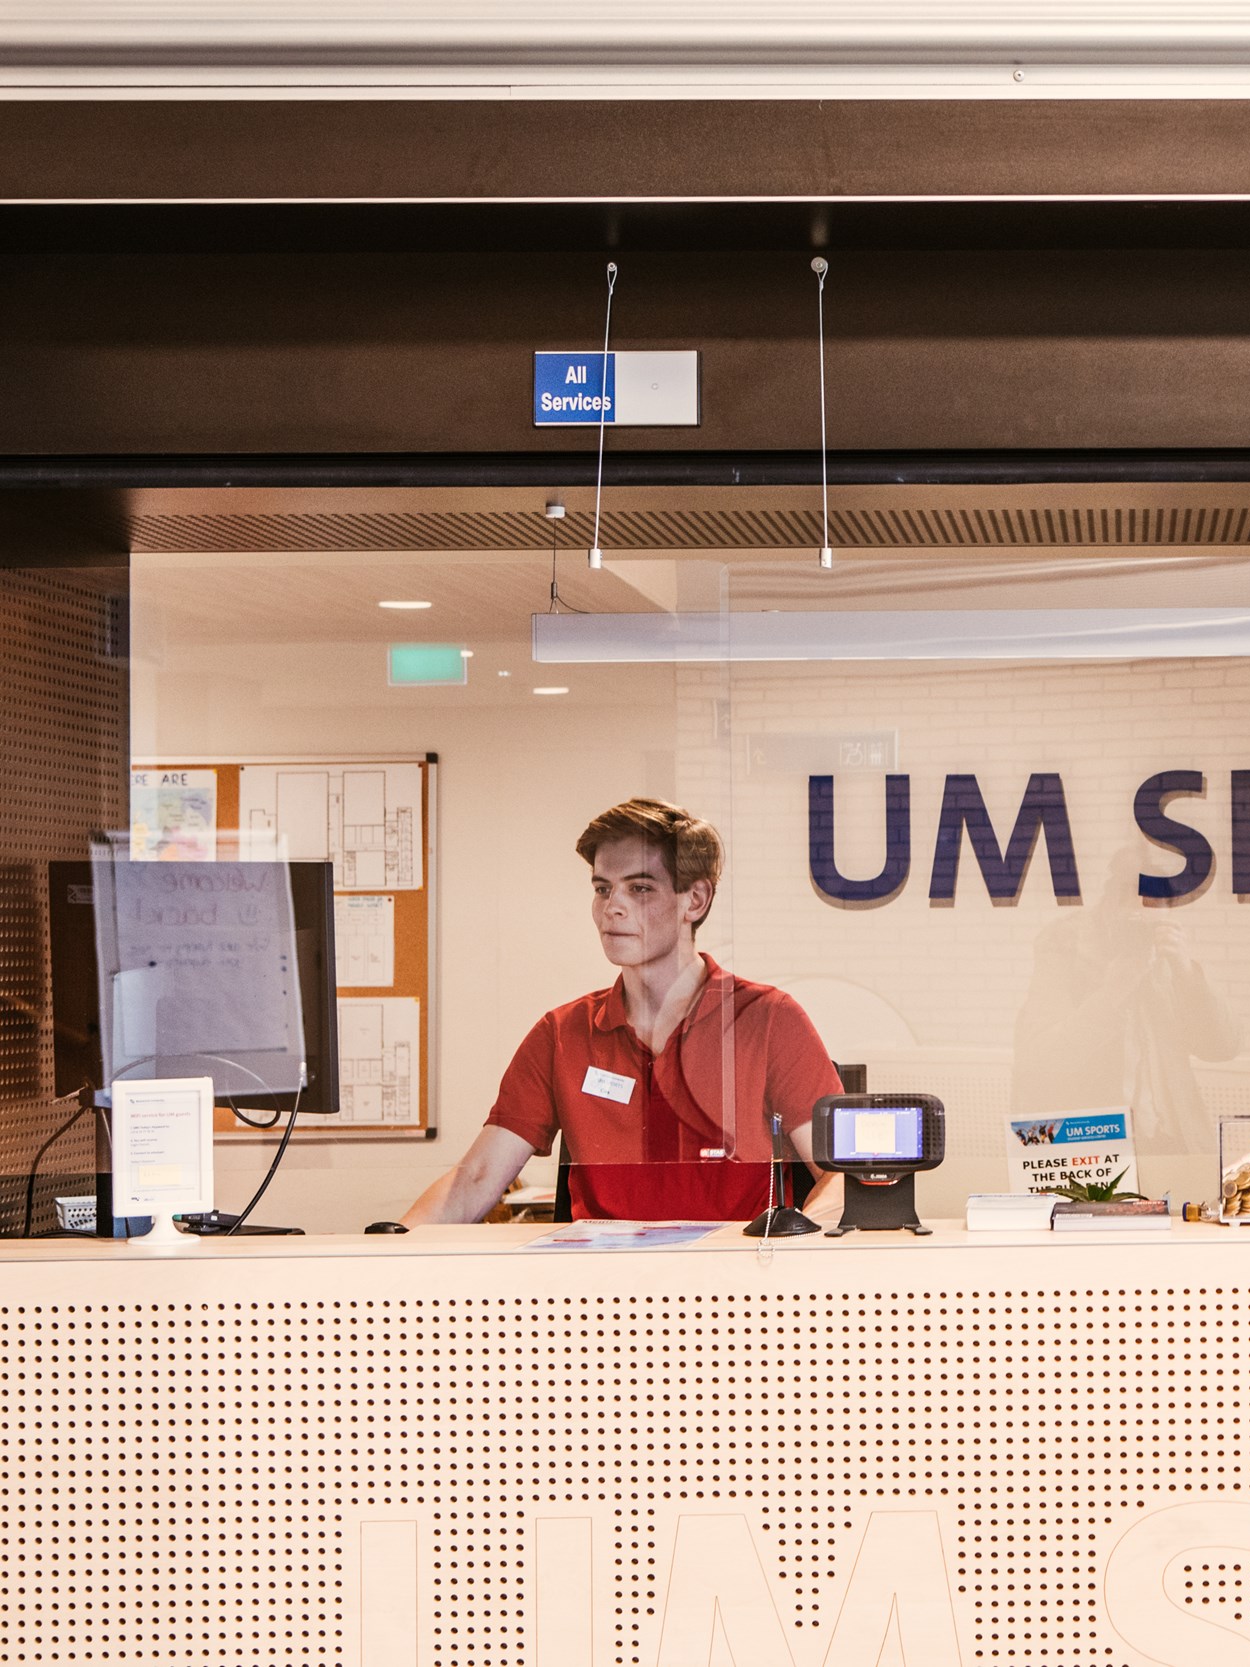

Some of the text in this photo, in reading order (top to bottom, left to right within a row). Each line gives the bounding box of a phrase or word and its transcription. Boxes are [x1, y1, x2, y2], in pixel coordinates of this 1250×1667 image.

[565, 366, 586, 384] All
[541, 392, 611, 411] Services
[161, 773, 188, 786] ARE
[809, 773, 1081, 900] UM
[1066, 1124, 1120, 1137] UM SPORTS
[1023, 1154, 1119, 1170] PLEASE EXIT AT
[1032, 1168, 1112, 1182] THE BACK OF
